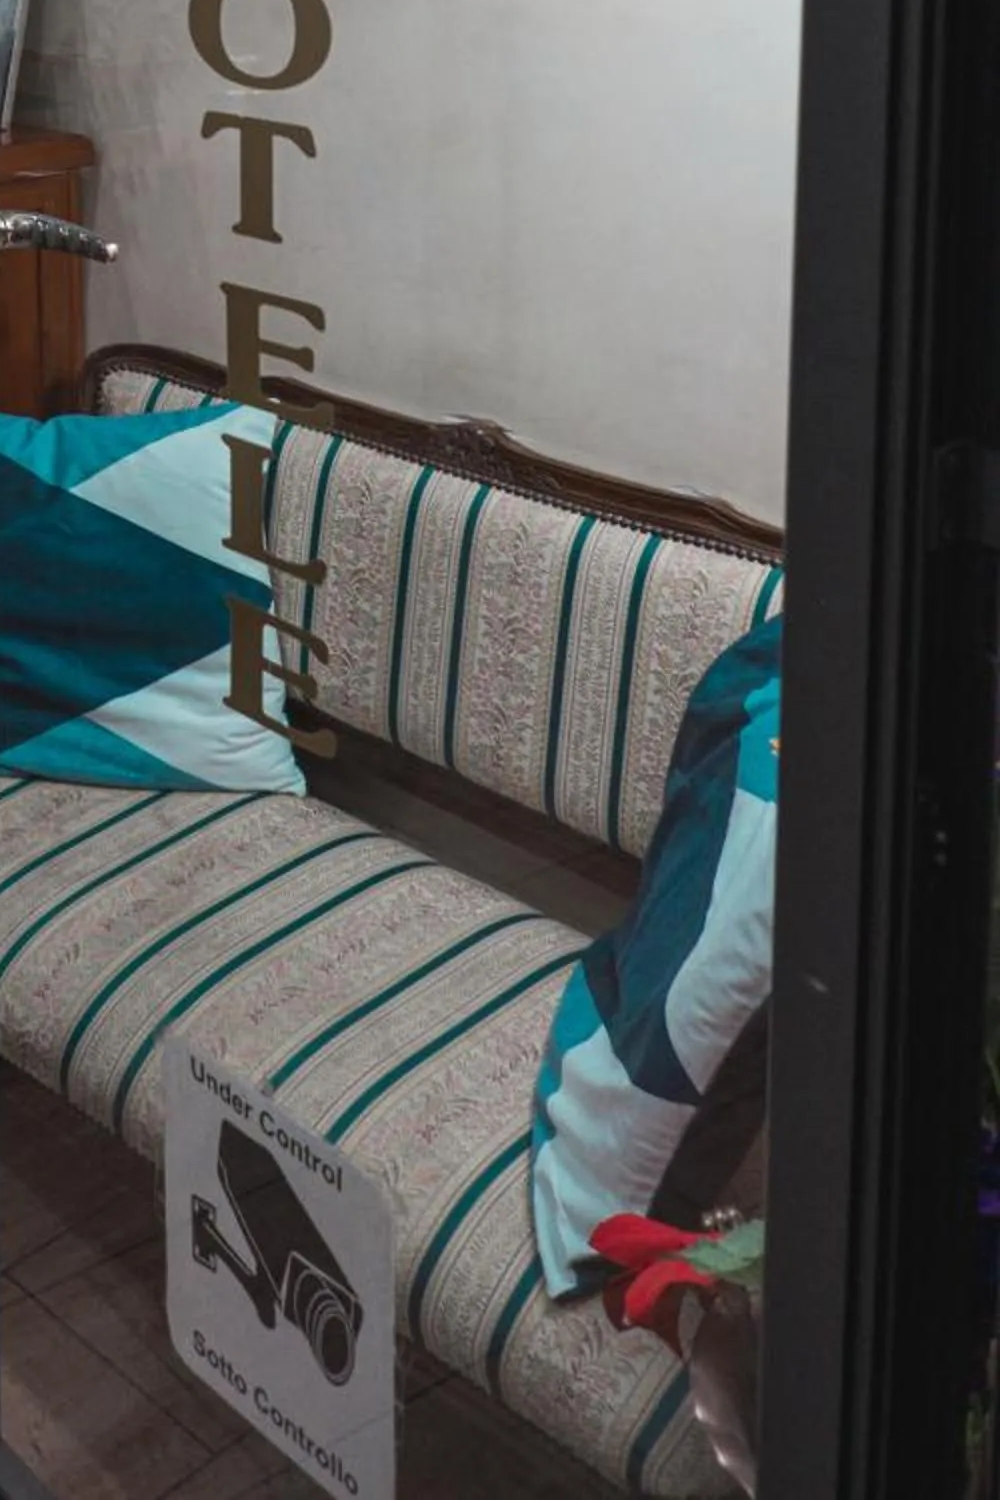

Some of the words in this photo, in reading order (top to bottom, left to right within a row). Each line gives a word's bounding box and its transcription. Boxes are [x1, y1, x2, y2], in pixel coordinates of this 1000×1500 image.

[190, 1054, 253, 1121] Under
[259, 1109, 344, 1193] Control
[192, 1329, 248, 1396] Sotto
[253, 1385, 359, 1497] Controllo
